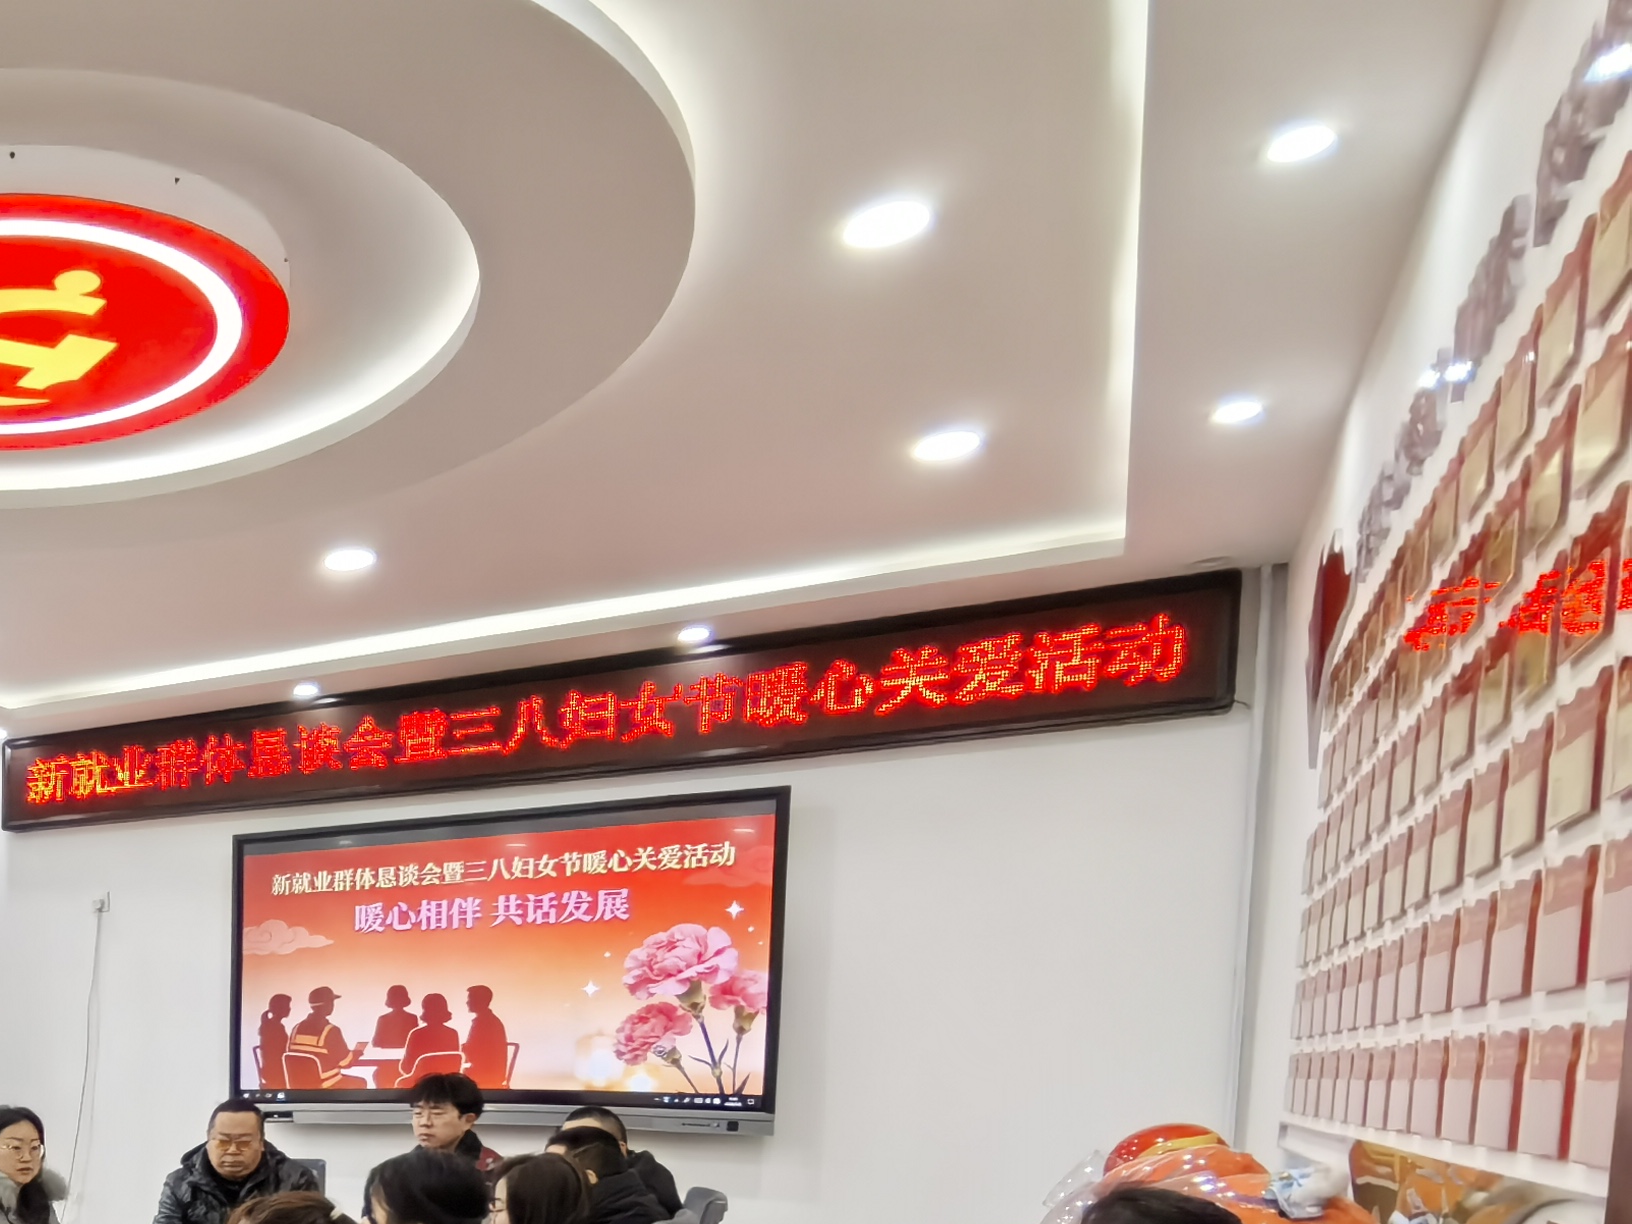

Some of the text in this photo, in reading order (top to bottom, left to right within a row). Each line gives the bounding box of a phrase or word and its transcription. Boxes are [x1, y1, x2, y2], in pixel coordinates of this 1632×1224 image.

[270, 841, 737, 896] 新就业群体恳谈会暨三八妇女节暖心关爱活动
[354, 888, 630, 934] 暖心相伴 共话发展
